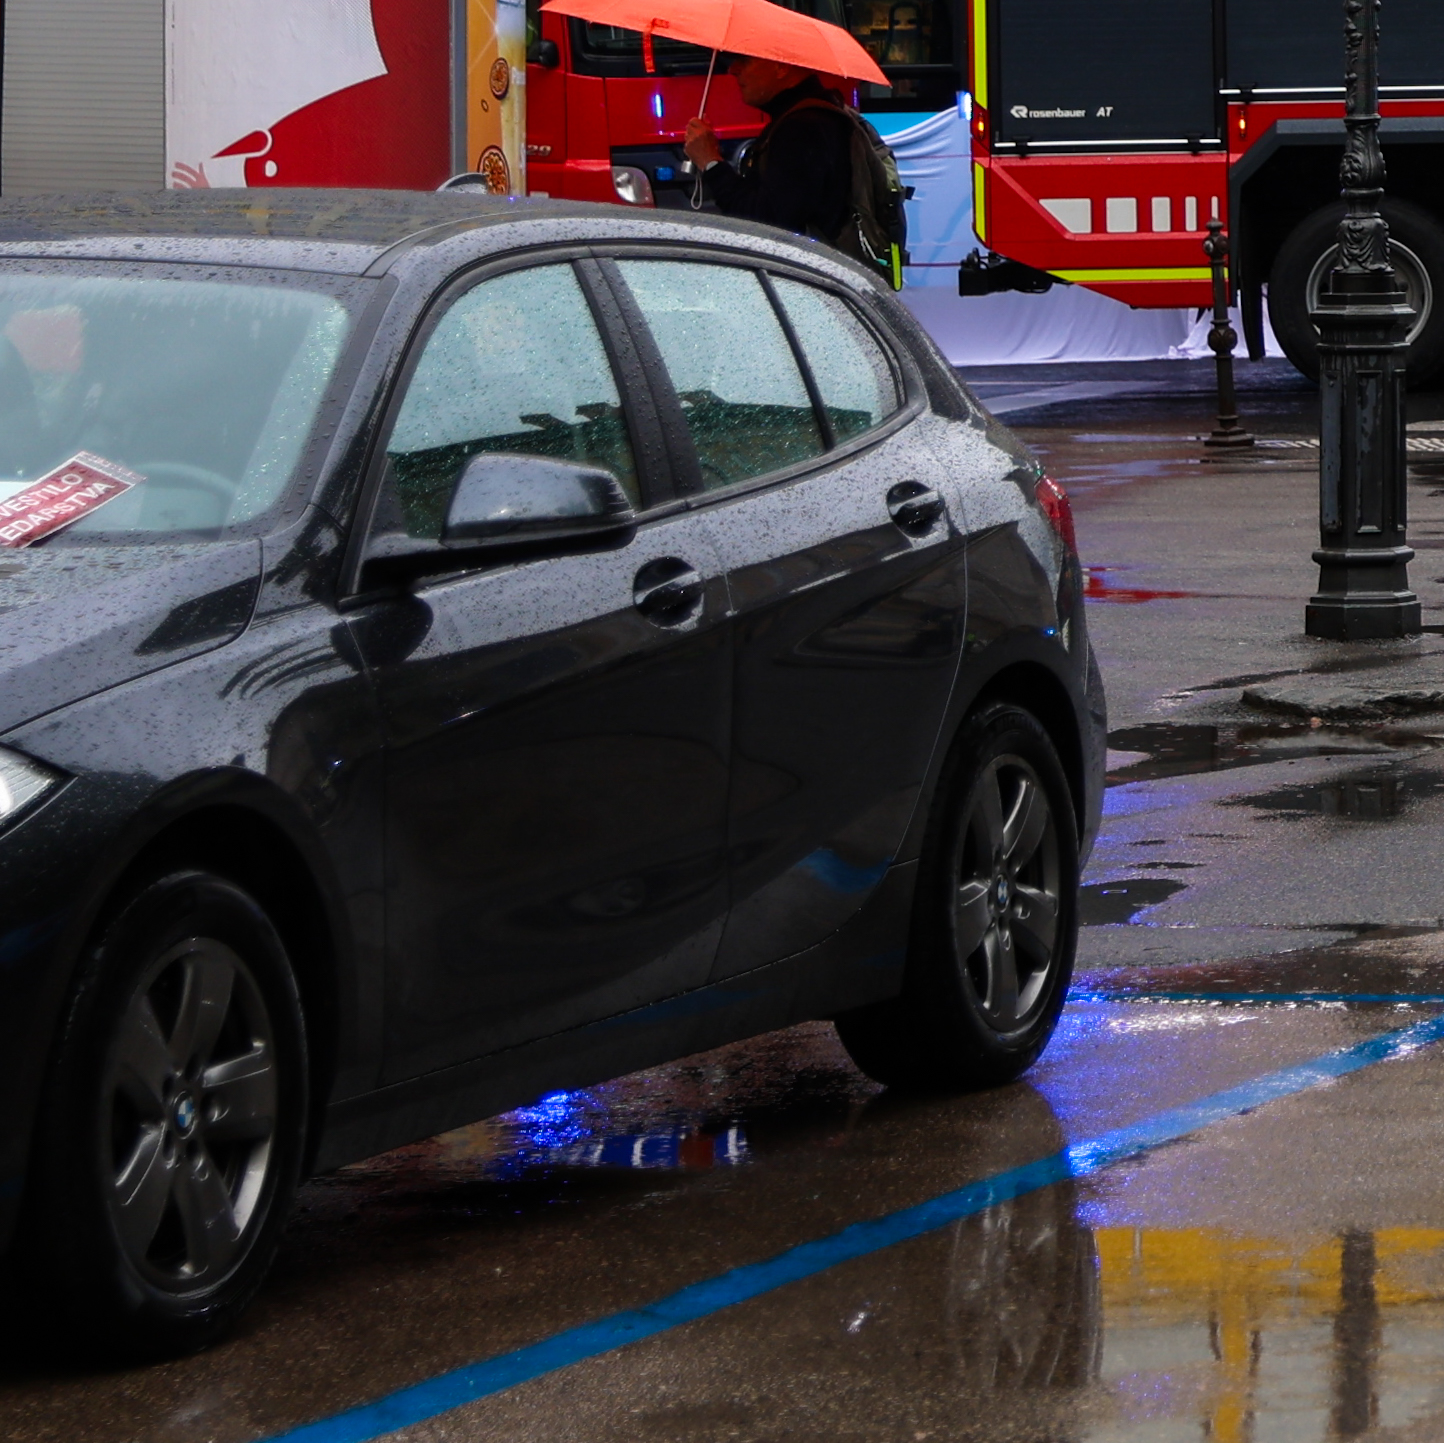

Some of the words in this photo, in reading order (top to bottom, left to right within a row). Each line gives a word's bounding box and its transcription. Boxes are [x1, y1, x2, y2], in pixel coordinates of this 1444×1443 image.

[1029, 107, 1087, 119] rosenbauer
[1096, 106, 1114, 118] AT
[0, 472, 84, 522] VESTILO
[0, 481, 116, 546] EDARSTVA
